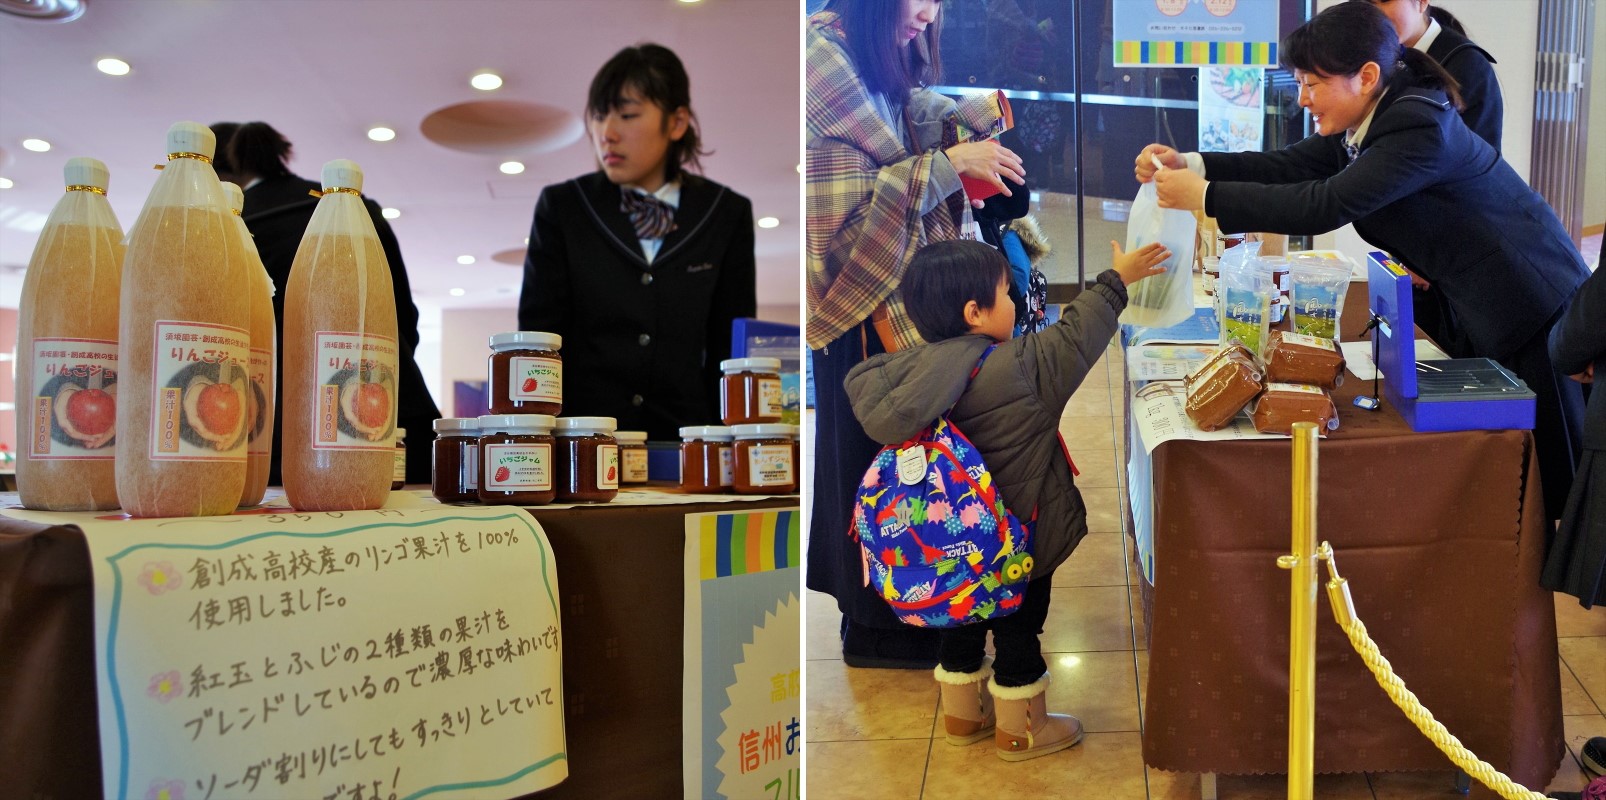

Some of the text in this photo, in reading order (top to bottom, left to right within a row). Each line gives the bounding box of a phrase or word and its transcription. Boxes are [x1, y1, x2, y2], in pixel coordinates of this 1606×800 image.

[527, 369, 559, 379] いちごジャム
[38, 398, 48, 450] 果汁100%
[163, 389, 177, 450] 果汁100%
[499, 455, 541, 465] いちごジャム
[188, 586, 347, 631] 使用しました。
